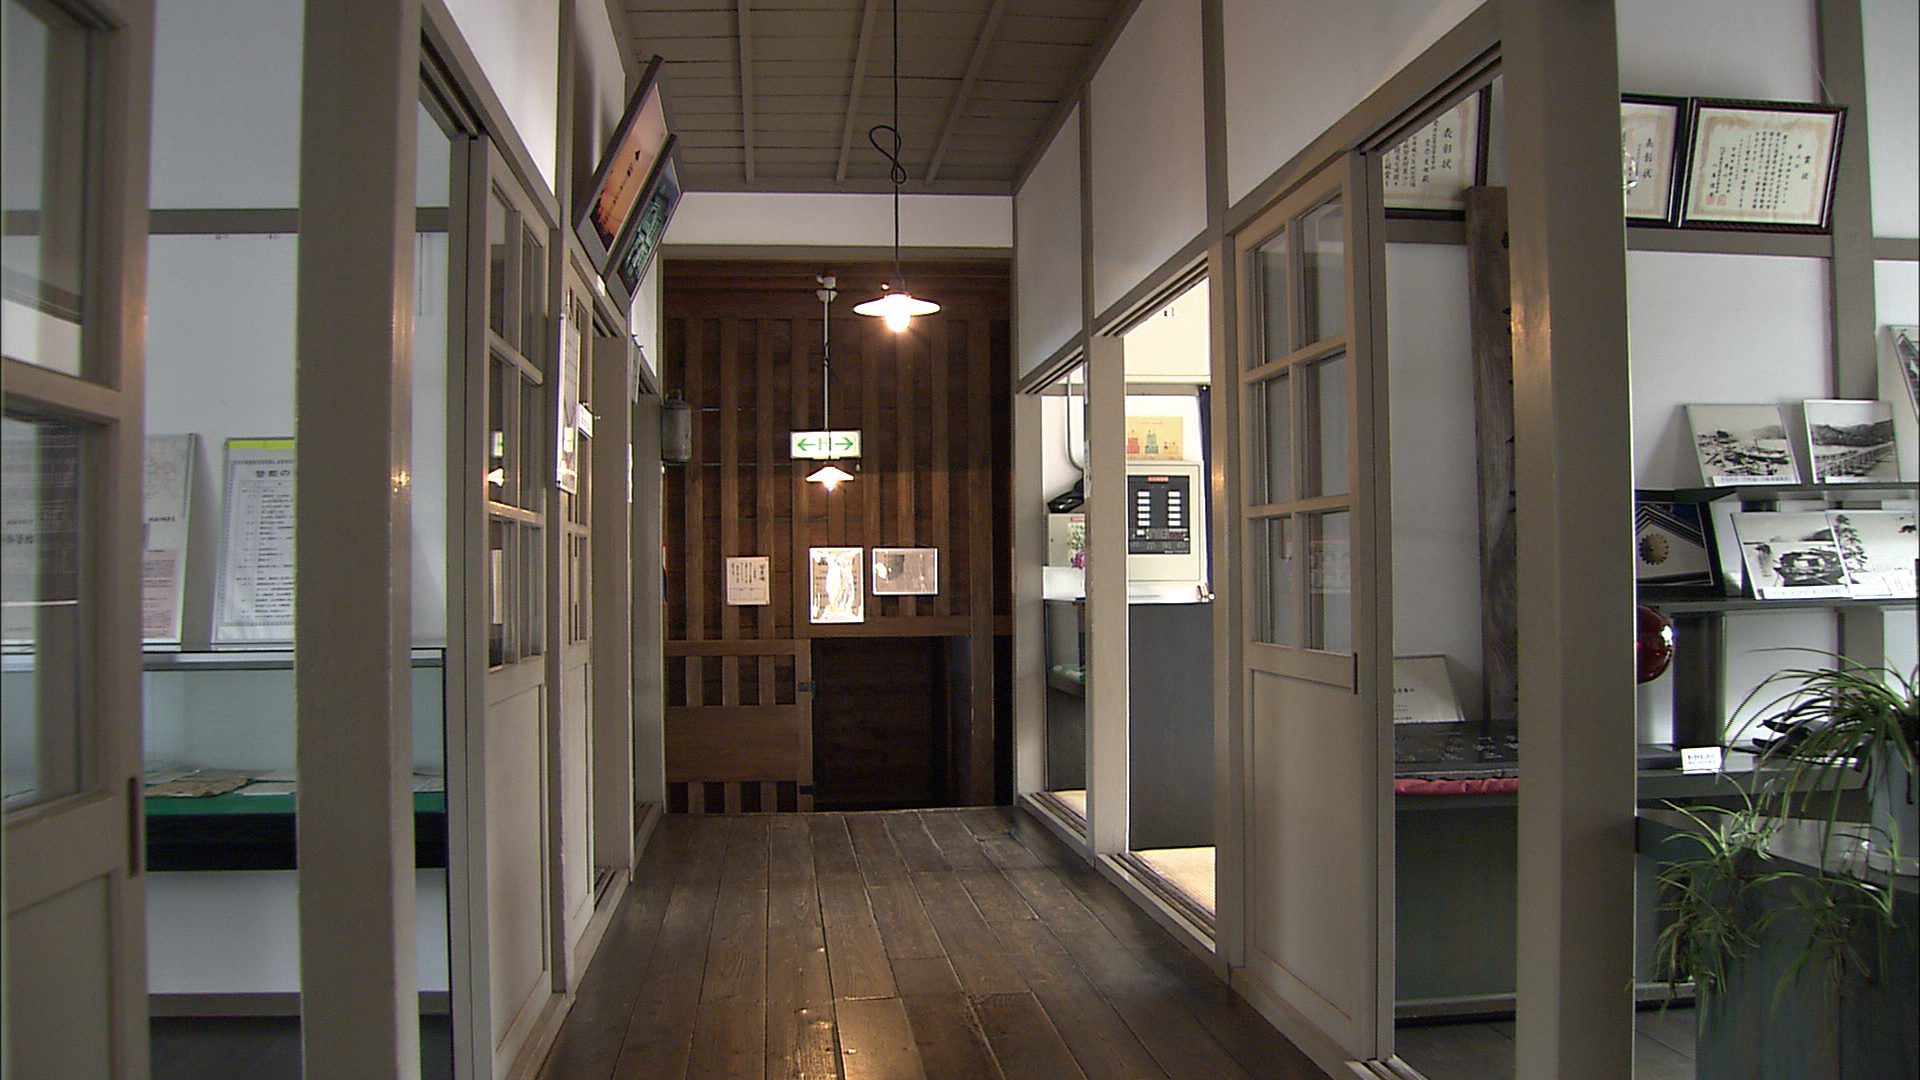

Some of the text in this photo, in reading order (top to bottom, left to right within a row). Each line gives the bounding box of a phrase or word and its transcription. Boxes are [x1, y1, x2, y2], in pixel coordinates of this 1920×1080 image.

[1441, 127, 1453, 170] 表彰状
[1642, 137, 1653, 179] 表彰状
